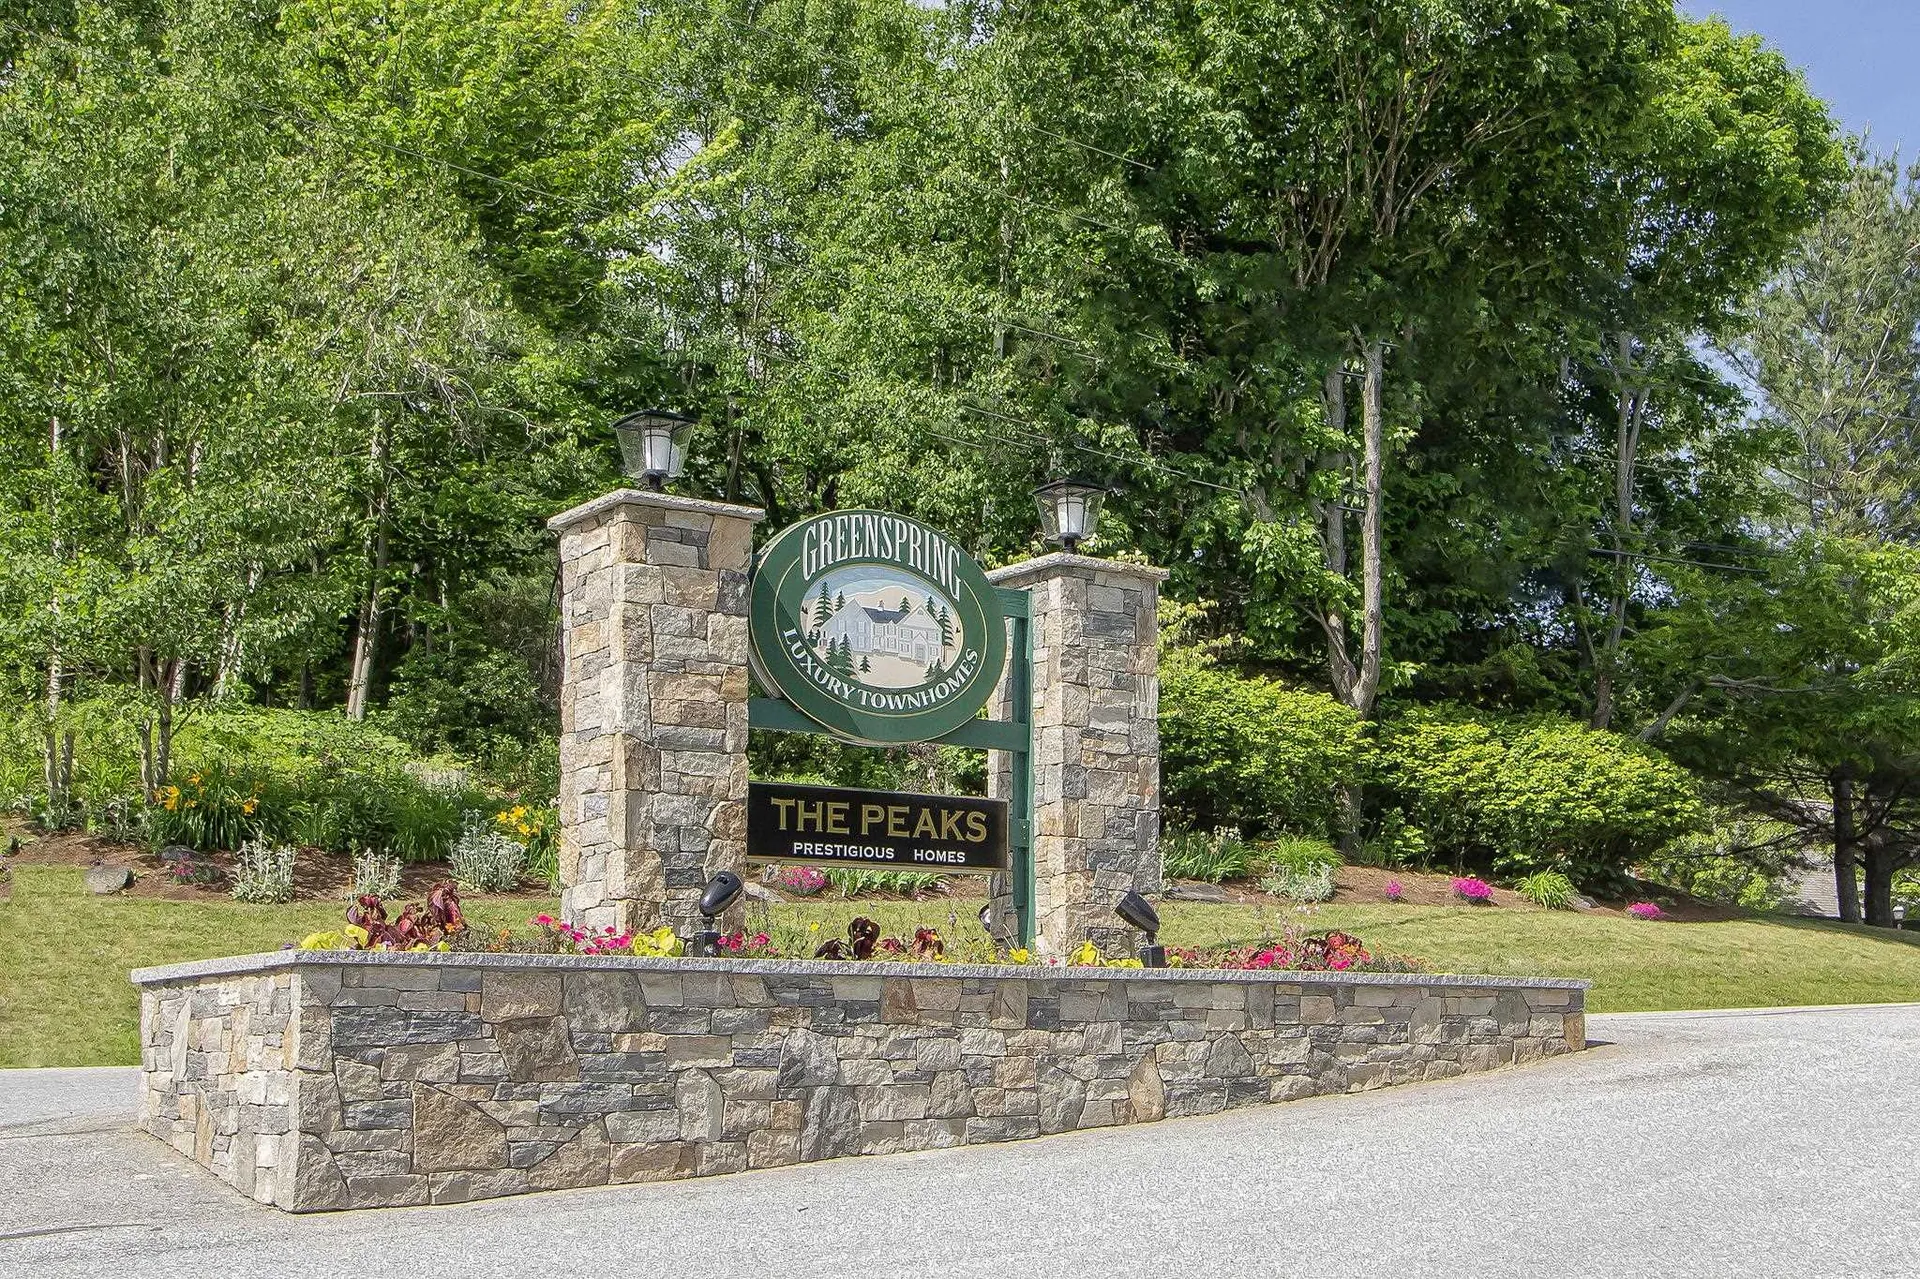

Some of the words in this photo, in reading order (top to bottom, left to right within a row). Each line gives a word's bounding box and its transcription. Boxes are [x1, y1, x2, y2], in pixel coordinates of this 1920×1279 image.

[803, 514, 961, 602] GREENSPRING
[783, 628, 857, 701] LUXURY
[857, 648, 979, 711] TOWNHOMES
[770, 796, 850, 835] THE
[861, 804, 988, 843] PEAKS
[793, 842, 895, 860] PRESTIGIOUS
[914, 849, 966, 863] HOMES
